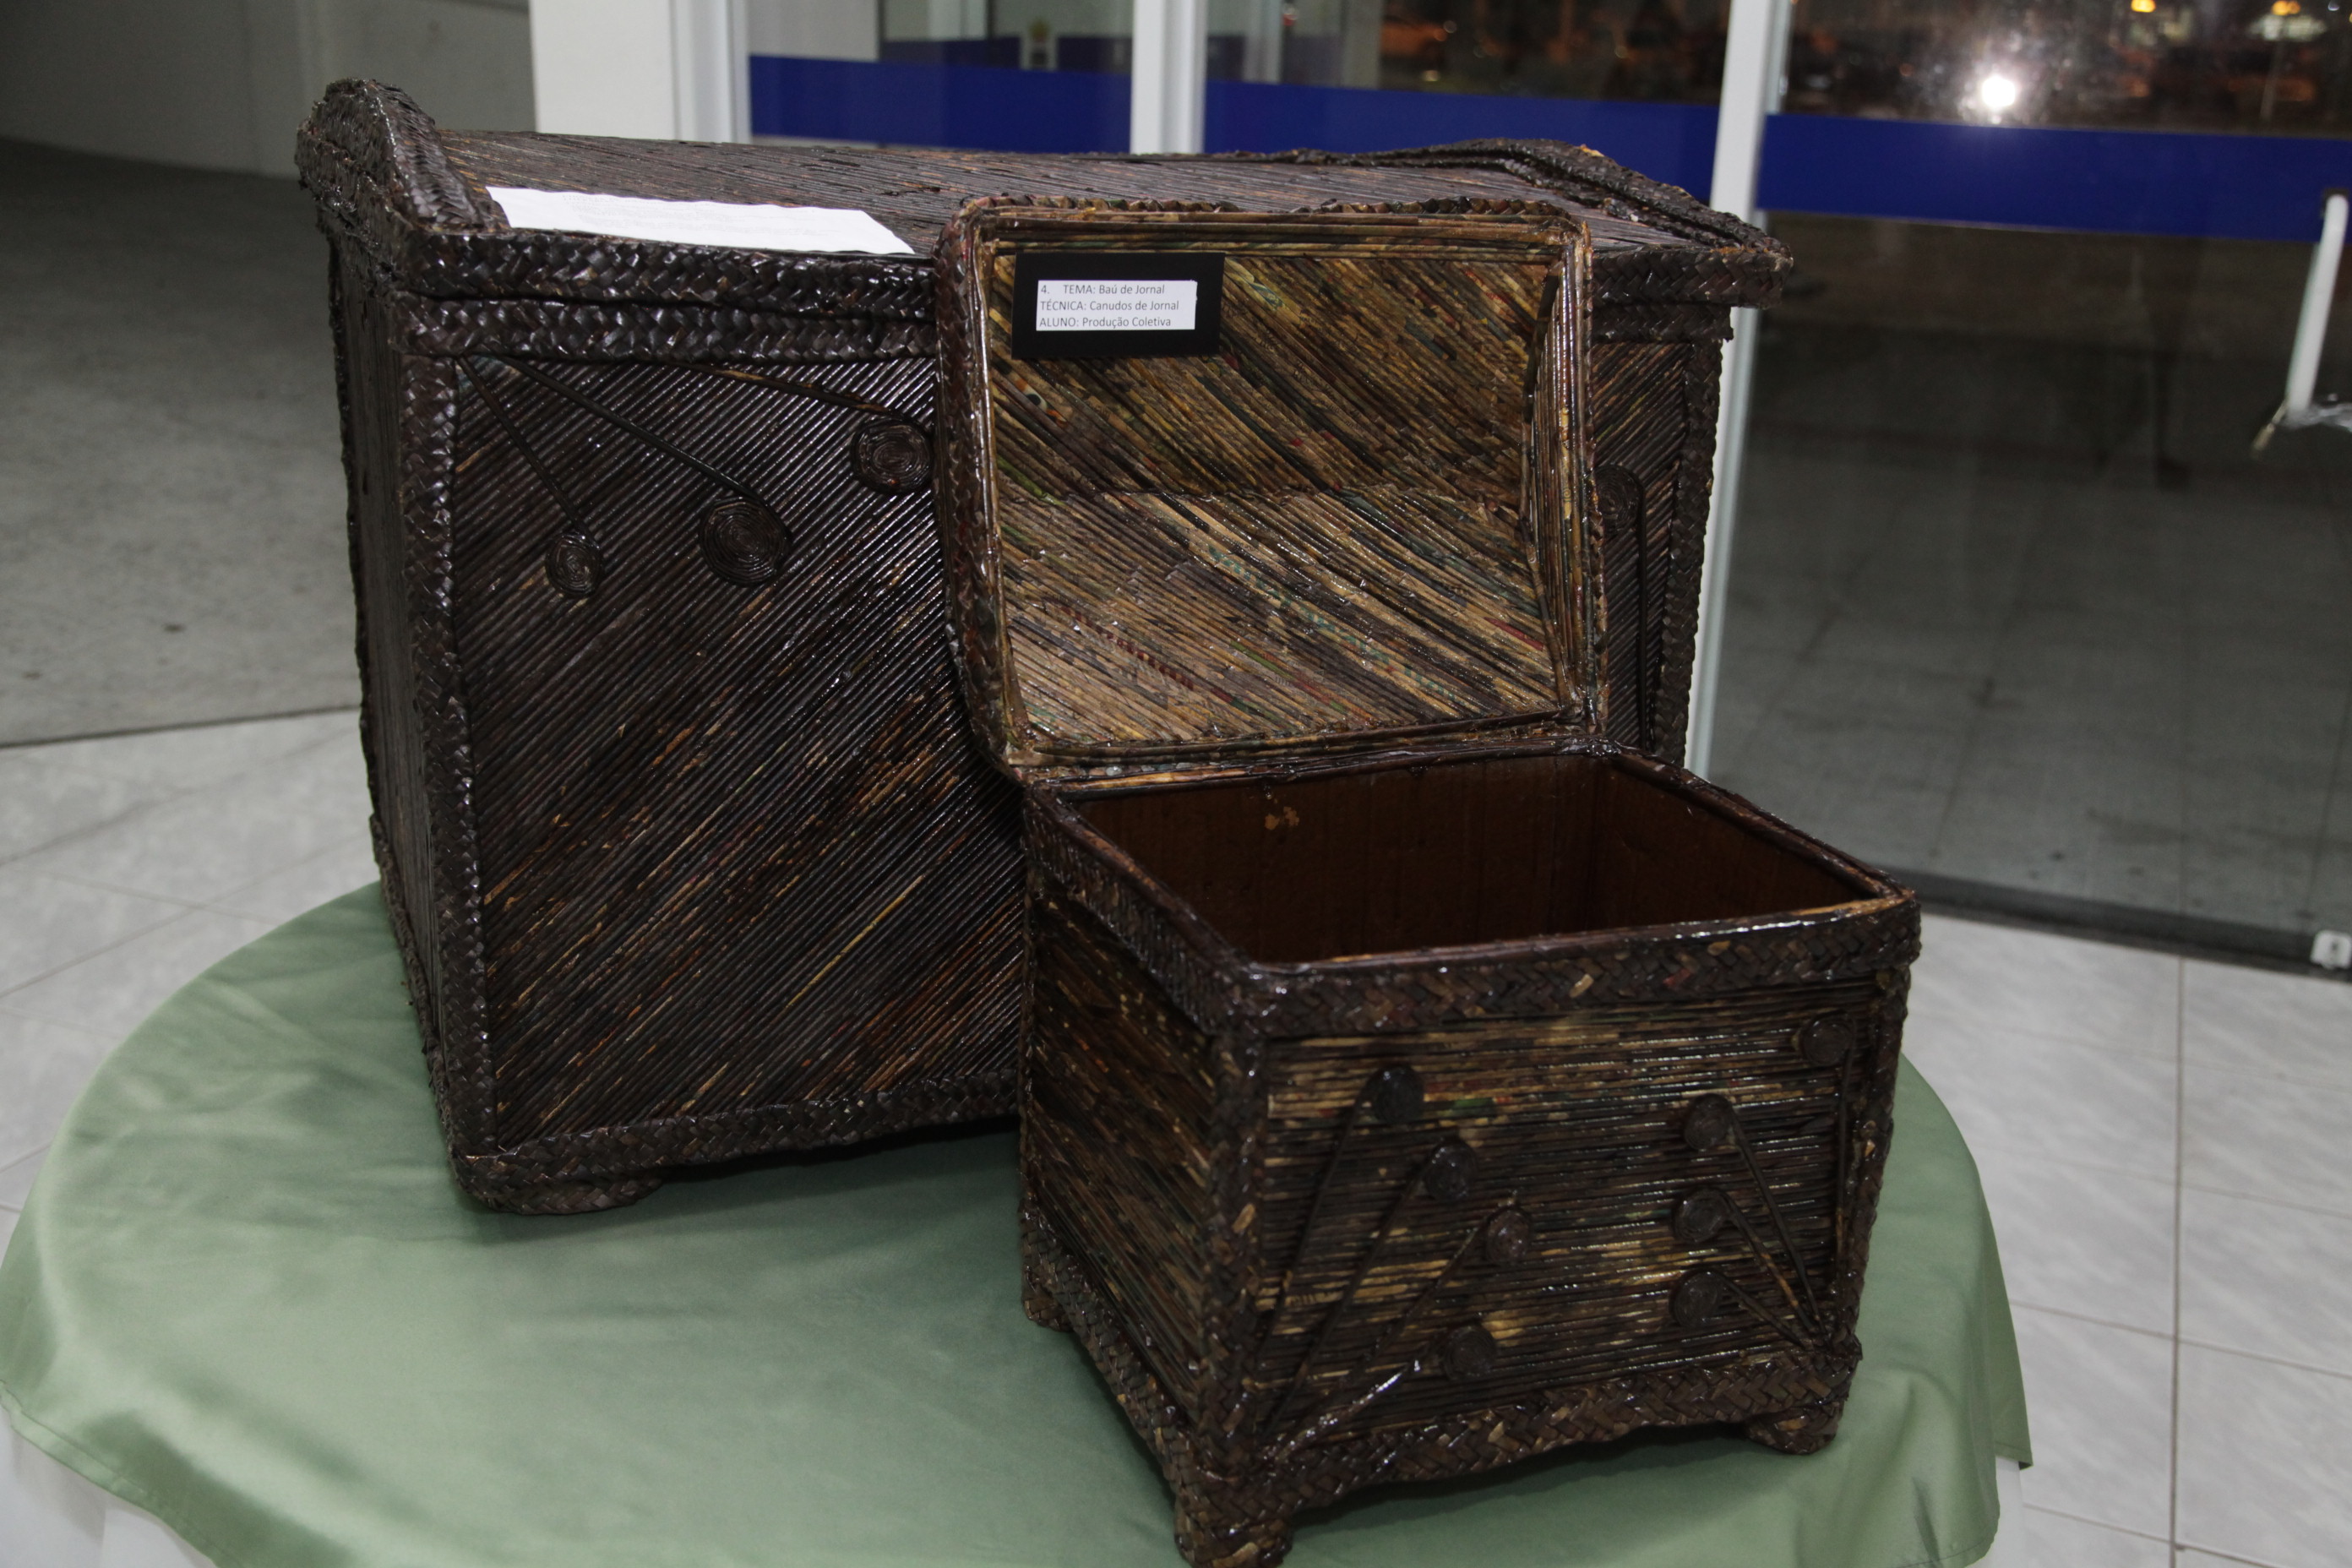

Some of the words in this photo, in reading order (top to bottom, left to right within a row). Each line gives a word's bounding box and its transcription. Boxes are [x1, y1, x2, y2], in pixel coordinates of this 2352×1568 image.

[1063, 284, 1096, 294] TEMA:
[1098, 284, 1118, 294] Baú
[1119, 284, 1133, 294] de
[1135, 284, 1165, 294] Jornal
[1040, 298, 1086, 311] TÉCNICA:
[1089, 300, 1132, 311] Canudos
[1135, 300, 1148, 311] de
[1150, 300, 1179, 311] Jornal
[1039, 317, 1080, 327] ALUNO:
[1082, 317, 1130, 329] Produção
[1131, 316, 1171, 327] Coletiva
